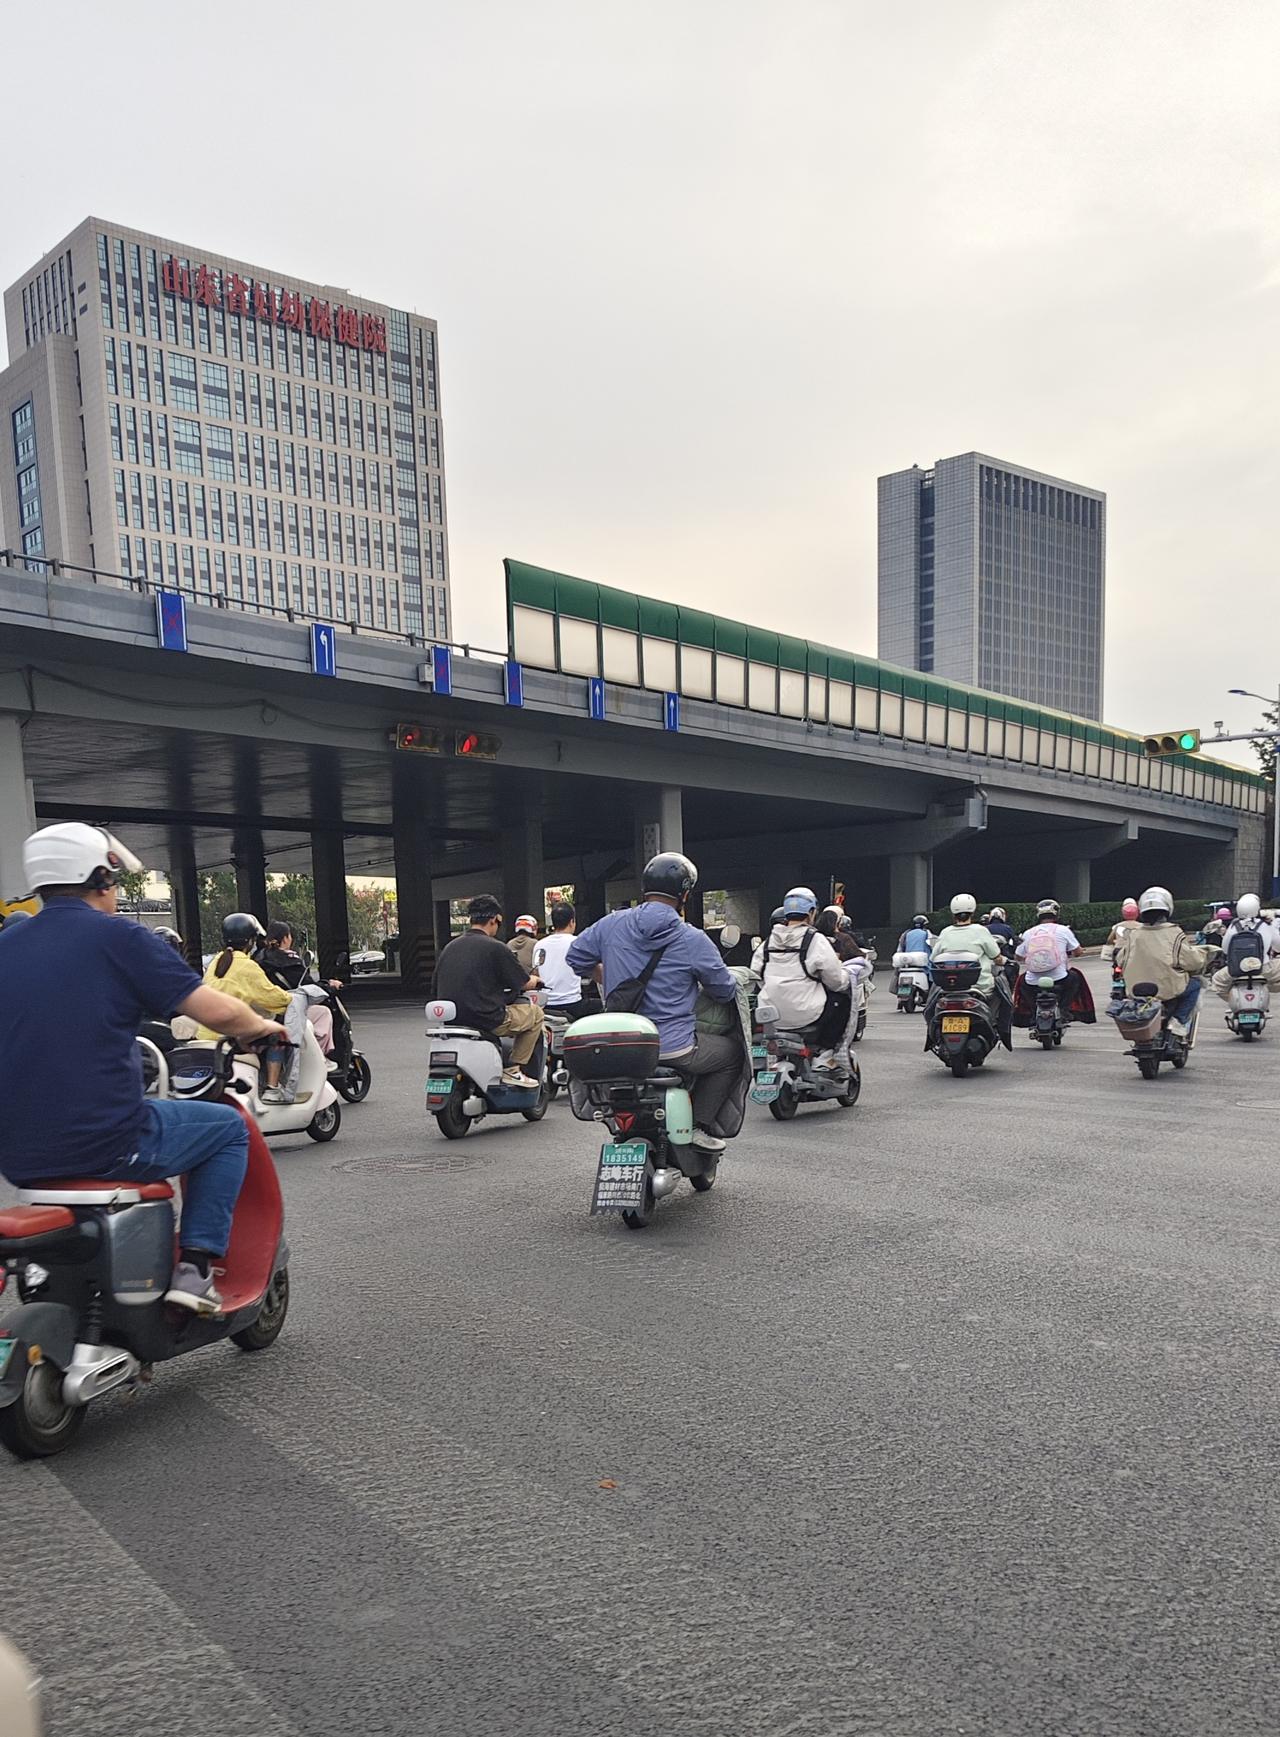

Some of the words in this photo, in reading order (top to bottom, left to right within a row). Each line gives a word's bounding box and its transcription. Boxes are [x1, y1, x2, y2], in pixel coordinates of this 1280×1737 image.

[162, 256, 388, 353] 山东省妇幼保健院
